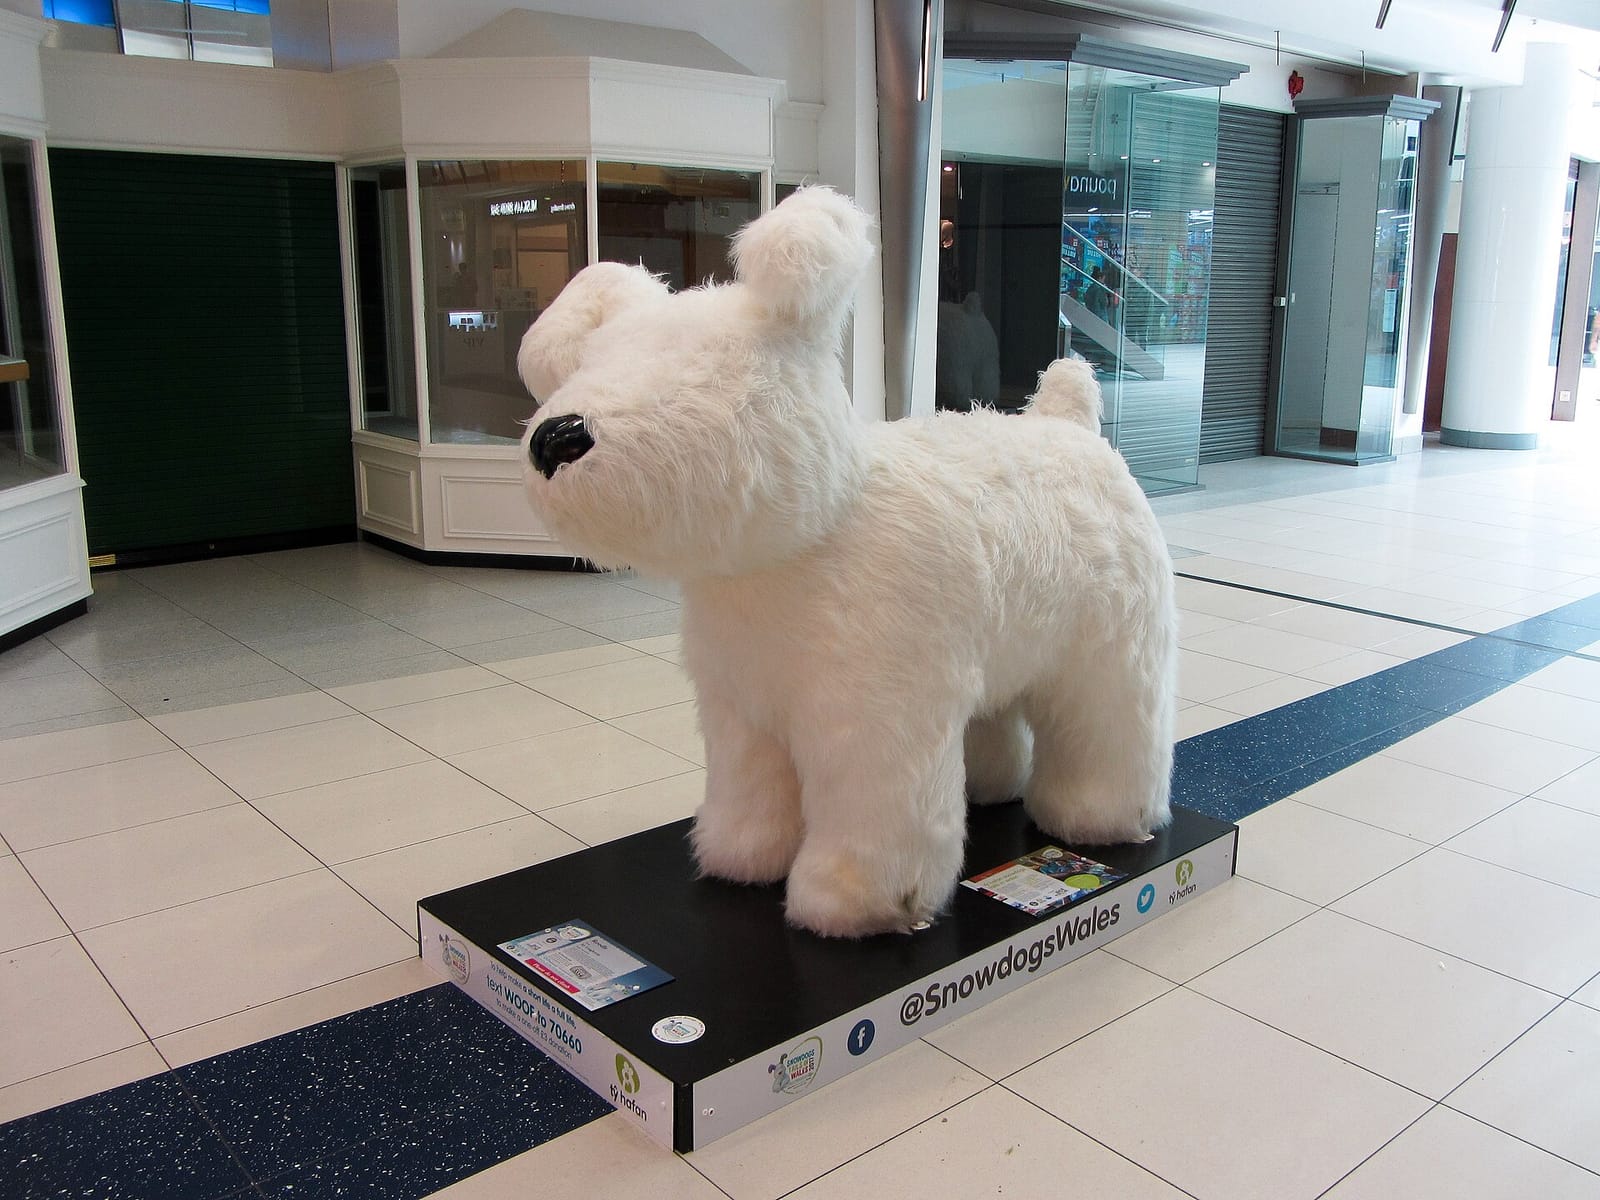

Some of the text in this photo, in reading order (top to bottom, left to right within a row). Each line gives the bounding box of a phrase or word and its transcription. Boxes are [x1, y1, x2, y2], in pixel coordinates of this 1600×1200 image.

[1176, 884, 1197, 900] hafan
[899, 902, 1121, 1026] @SnowdogsWales
[486, 974, 503, 997] text
[505, 987, 536, 1018] WOOF
[537, 1010, 547, 1028] to
[549, 1018, 582, 1054] 70660
[790, 1066, 809, 1080] WALES
[620, 1090, 647, 1121] hafan
